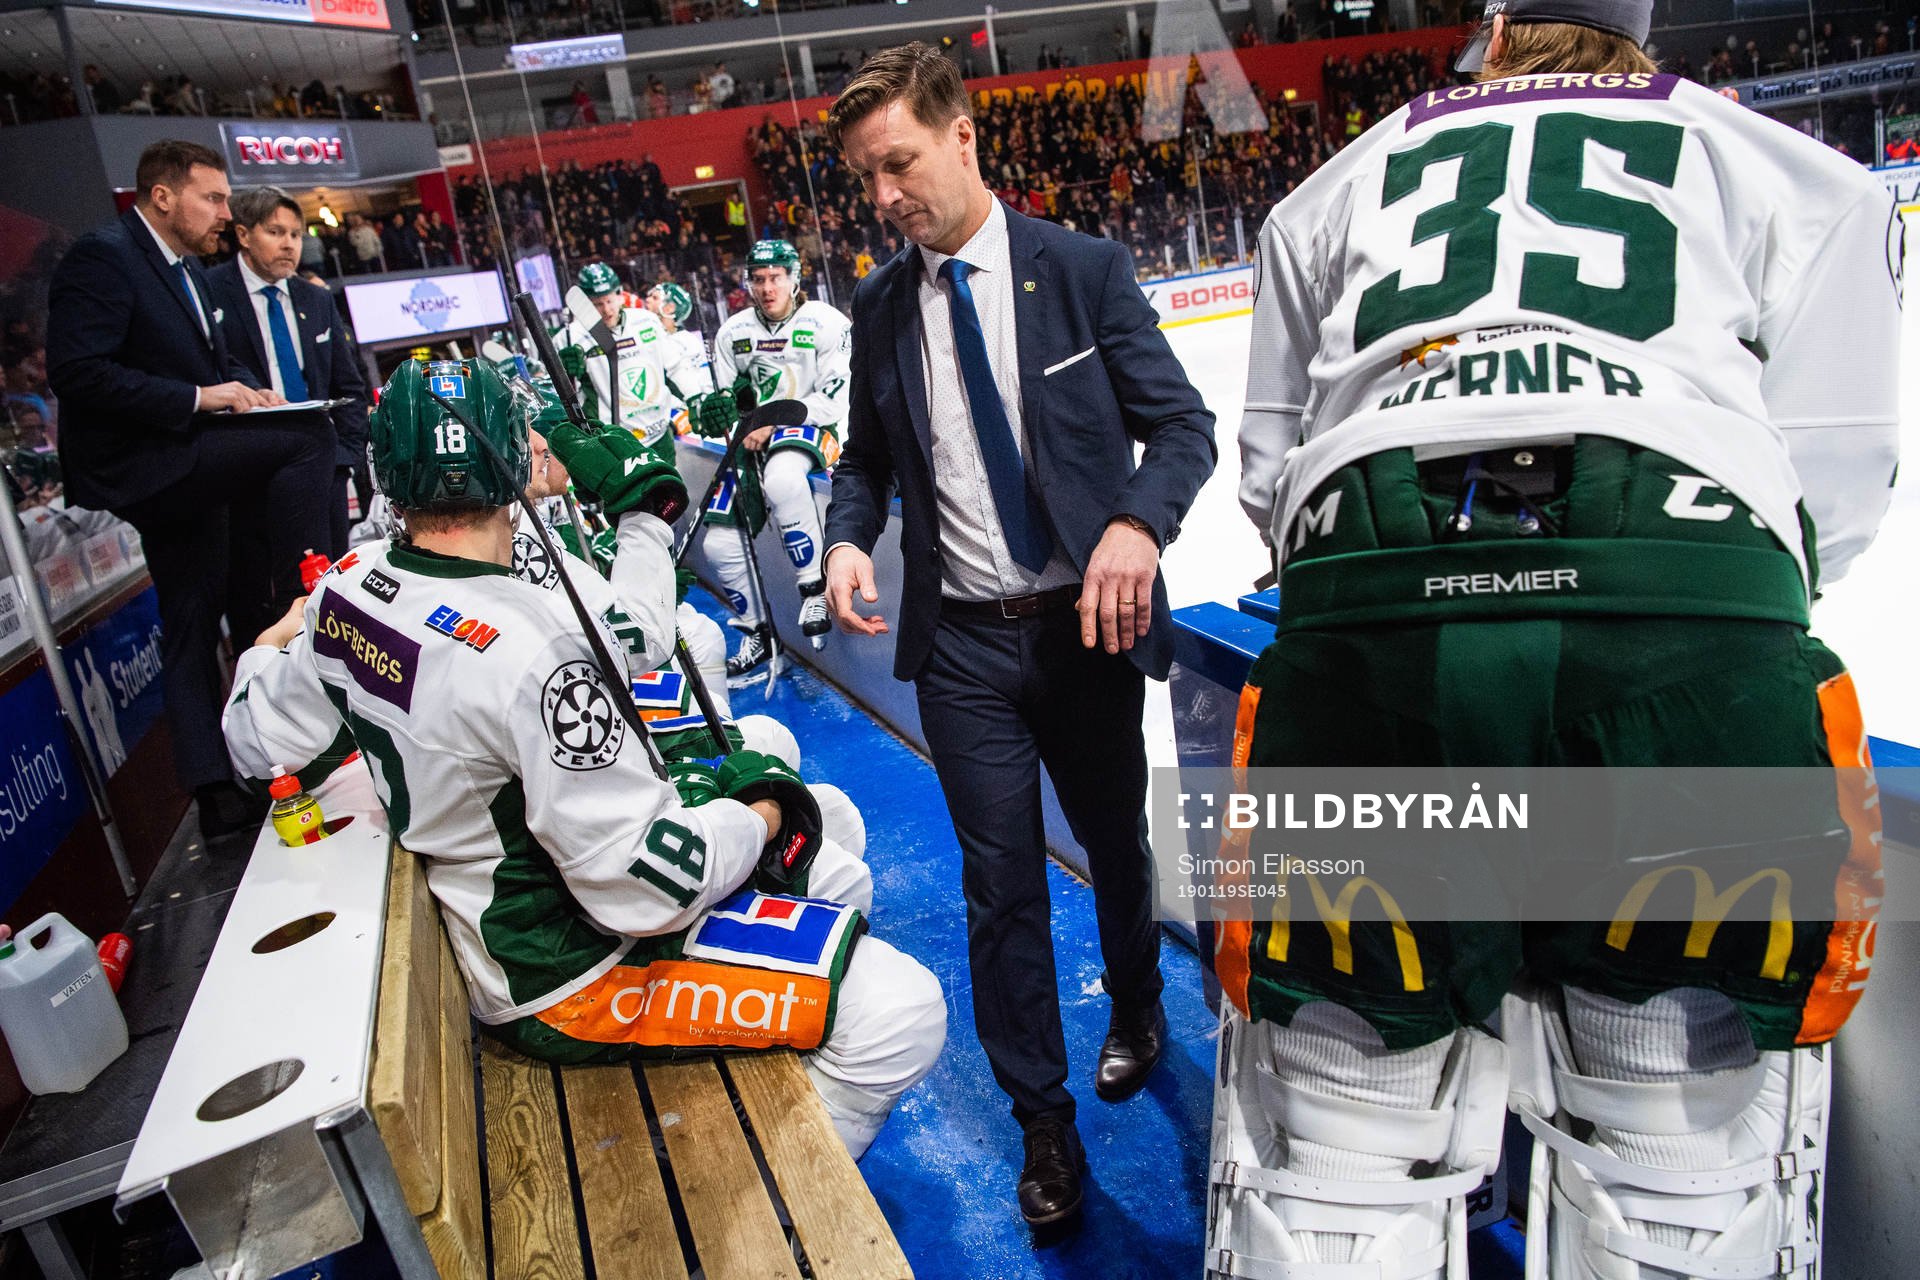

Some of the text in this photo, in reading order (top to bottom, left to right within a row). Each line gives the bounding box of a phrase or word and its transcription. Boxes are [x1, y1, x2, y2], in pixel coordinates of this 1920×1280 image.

[236, 136, 345, 165] RICOH
[1354, 112, 1684, 353] 35
[1171, 281, 1254, 310] BORG
[433, 424, 467, 455] 18
[366, 573, 398, 597] CCM
[1424, 568, 1579, 598] PREMIER
[424, 604, 500, 654] ELON
[315, 609, 403, 684] LÖFBERGS
[0, 743, 67, 842] sulting
[627, 817, 707, 909] 18
[62, 972, 92, 998] VATTEN
[689, 1024, 704, 1038] by
